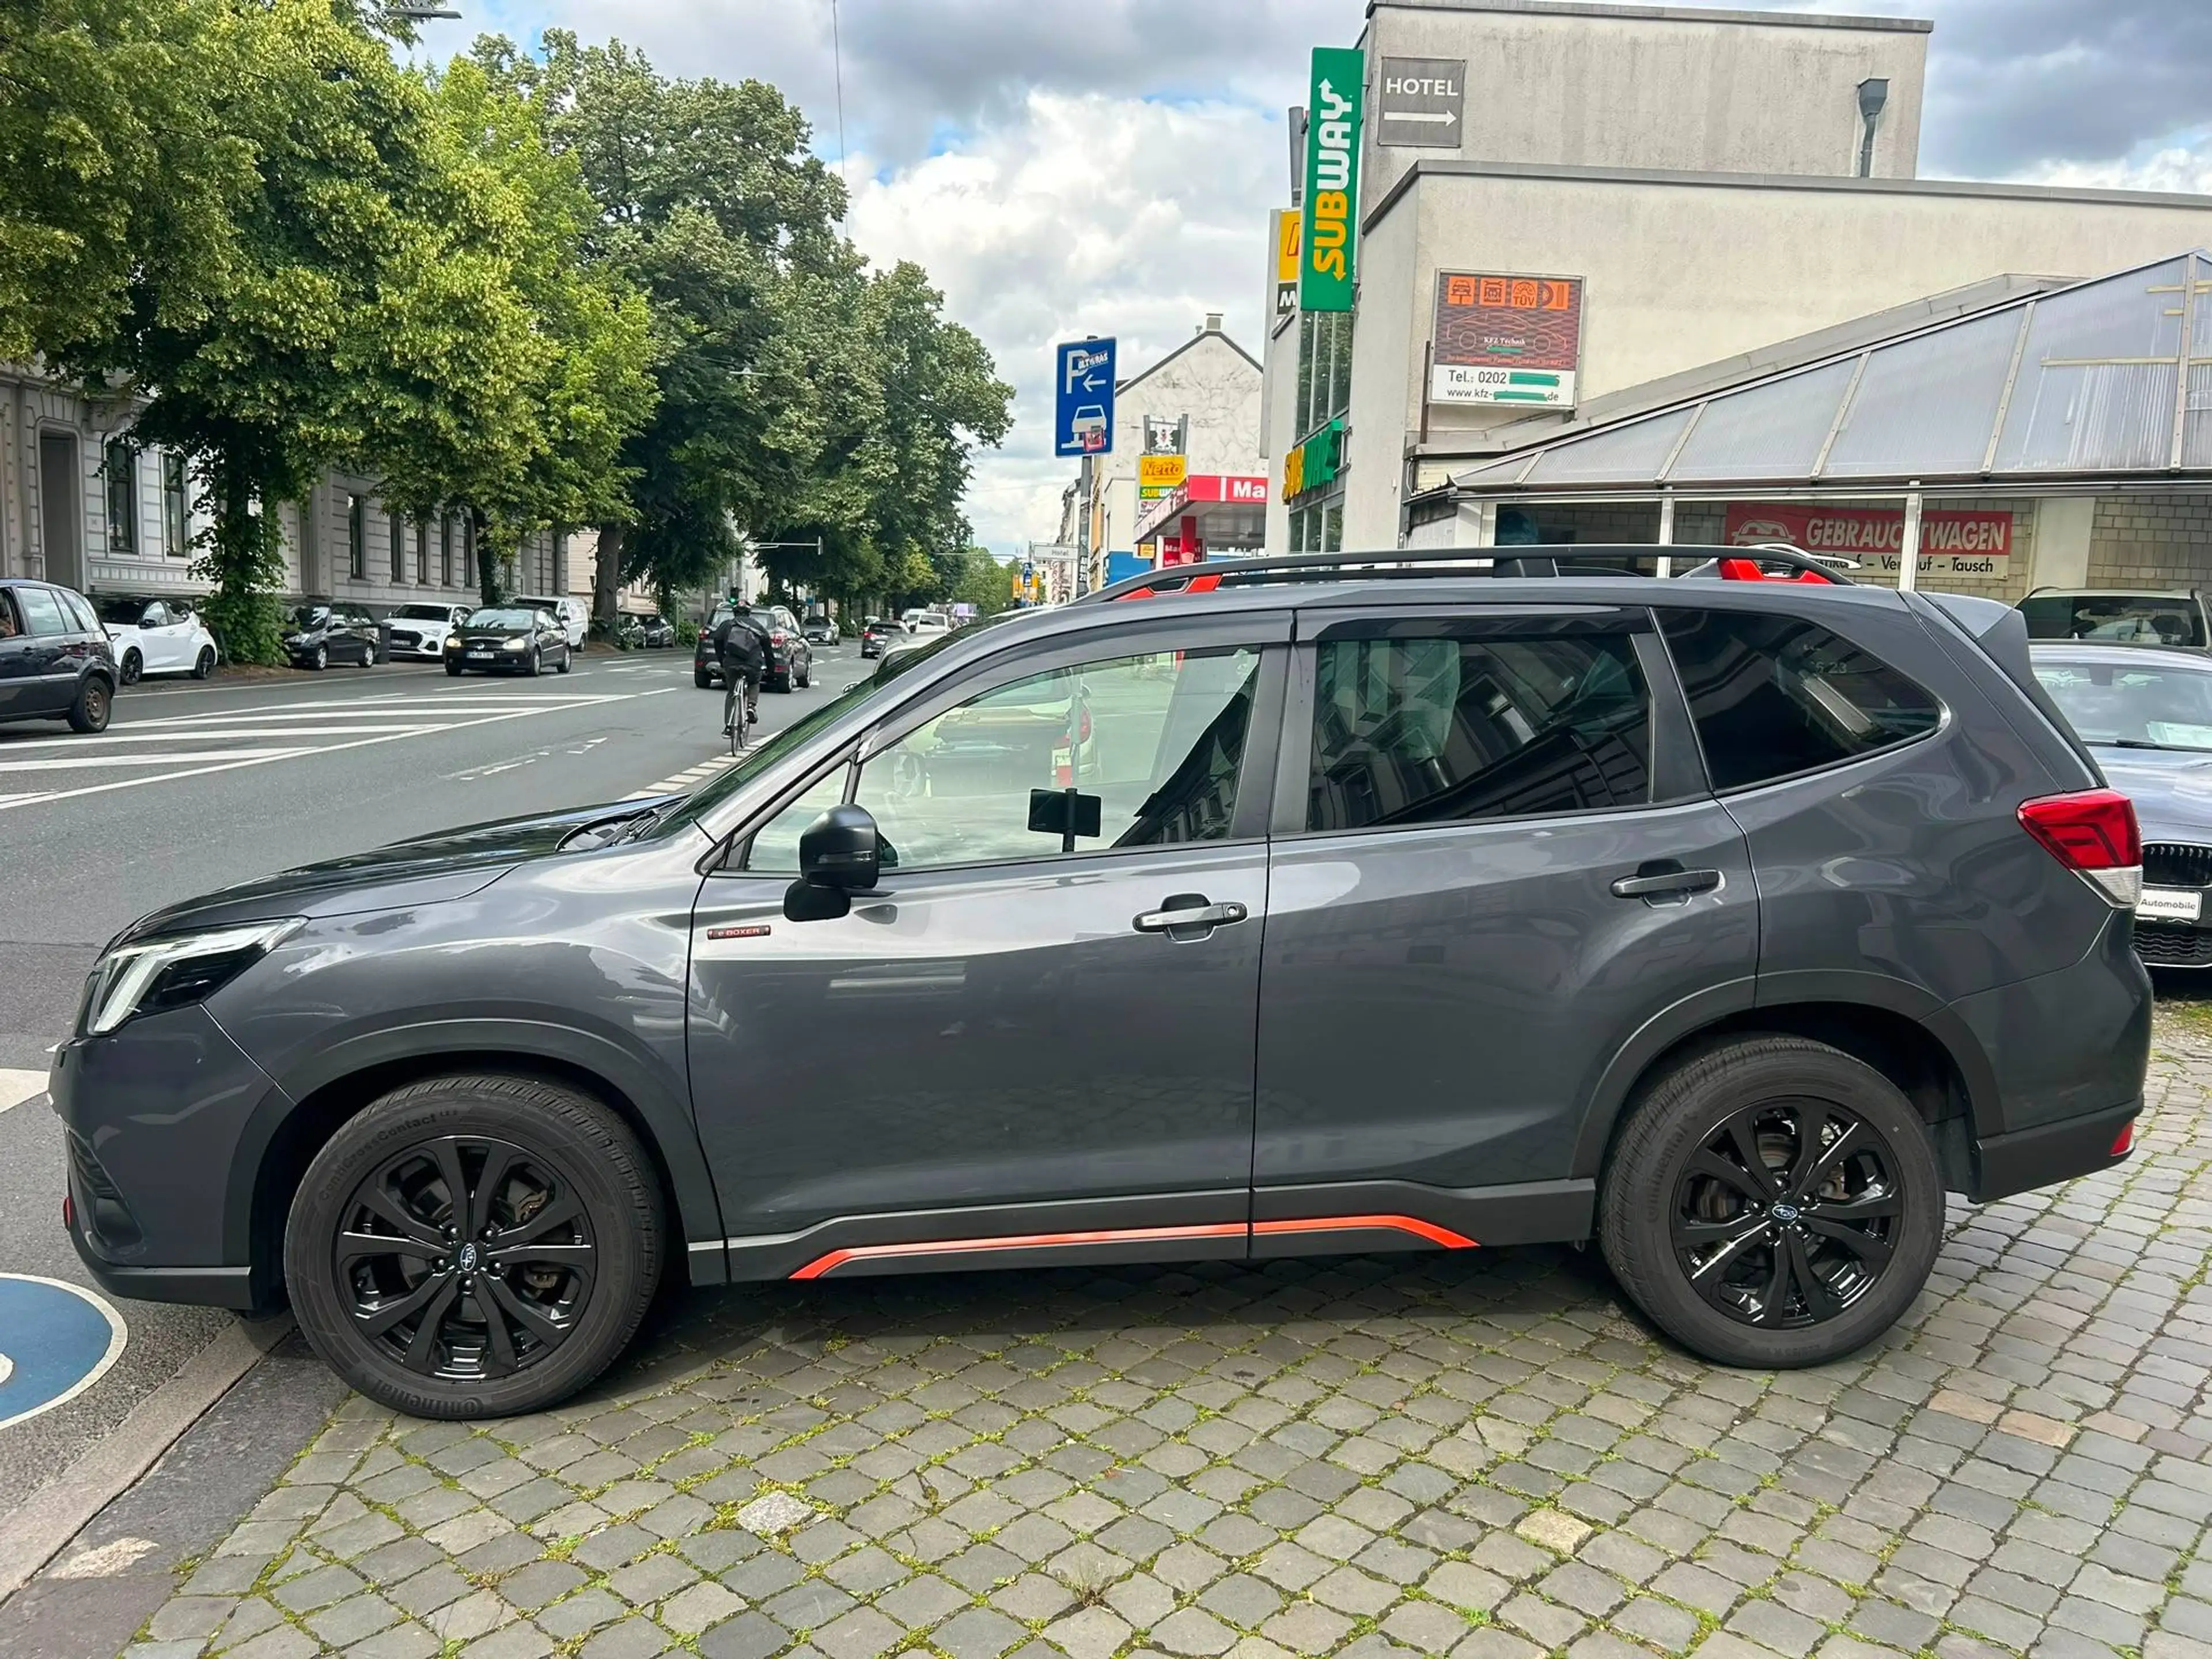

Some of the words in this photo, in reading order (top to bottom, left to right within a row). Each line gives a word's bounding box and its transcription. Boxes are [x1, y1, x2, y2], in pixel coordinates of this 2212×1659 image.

[1386, 78, 1459, 96] HOTEL
[1313, 78, 1353, 281] SUBWAY
[1513, 295, 1535, 306] TÜV
[1500, 337, 1526, 346] Technik
[1066, 349, 1090, 394] P
[1448, 369, 1474, 382] Tel.:
[1478, 371, 1507, 384] 0202
[1143, 461, 1181, 476] Netto
[1233, 480, 1266, 498] Ma
[1806, 518, 2006, 551] GEBRAUCTWAGEN
[1952, 556, 1993, 572] Tausch
[2141, 897, 2196, 910] Automobile
